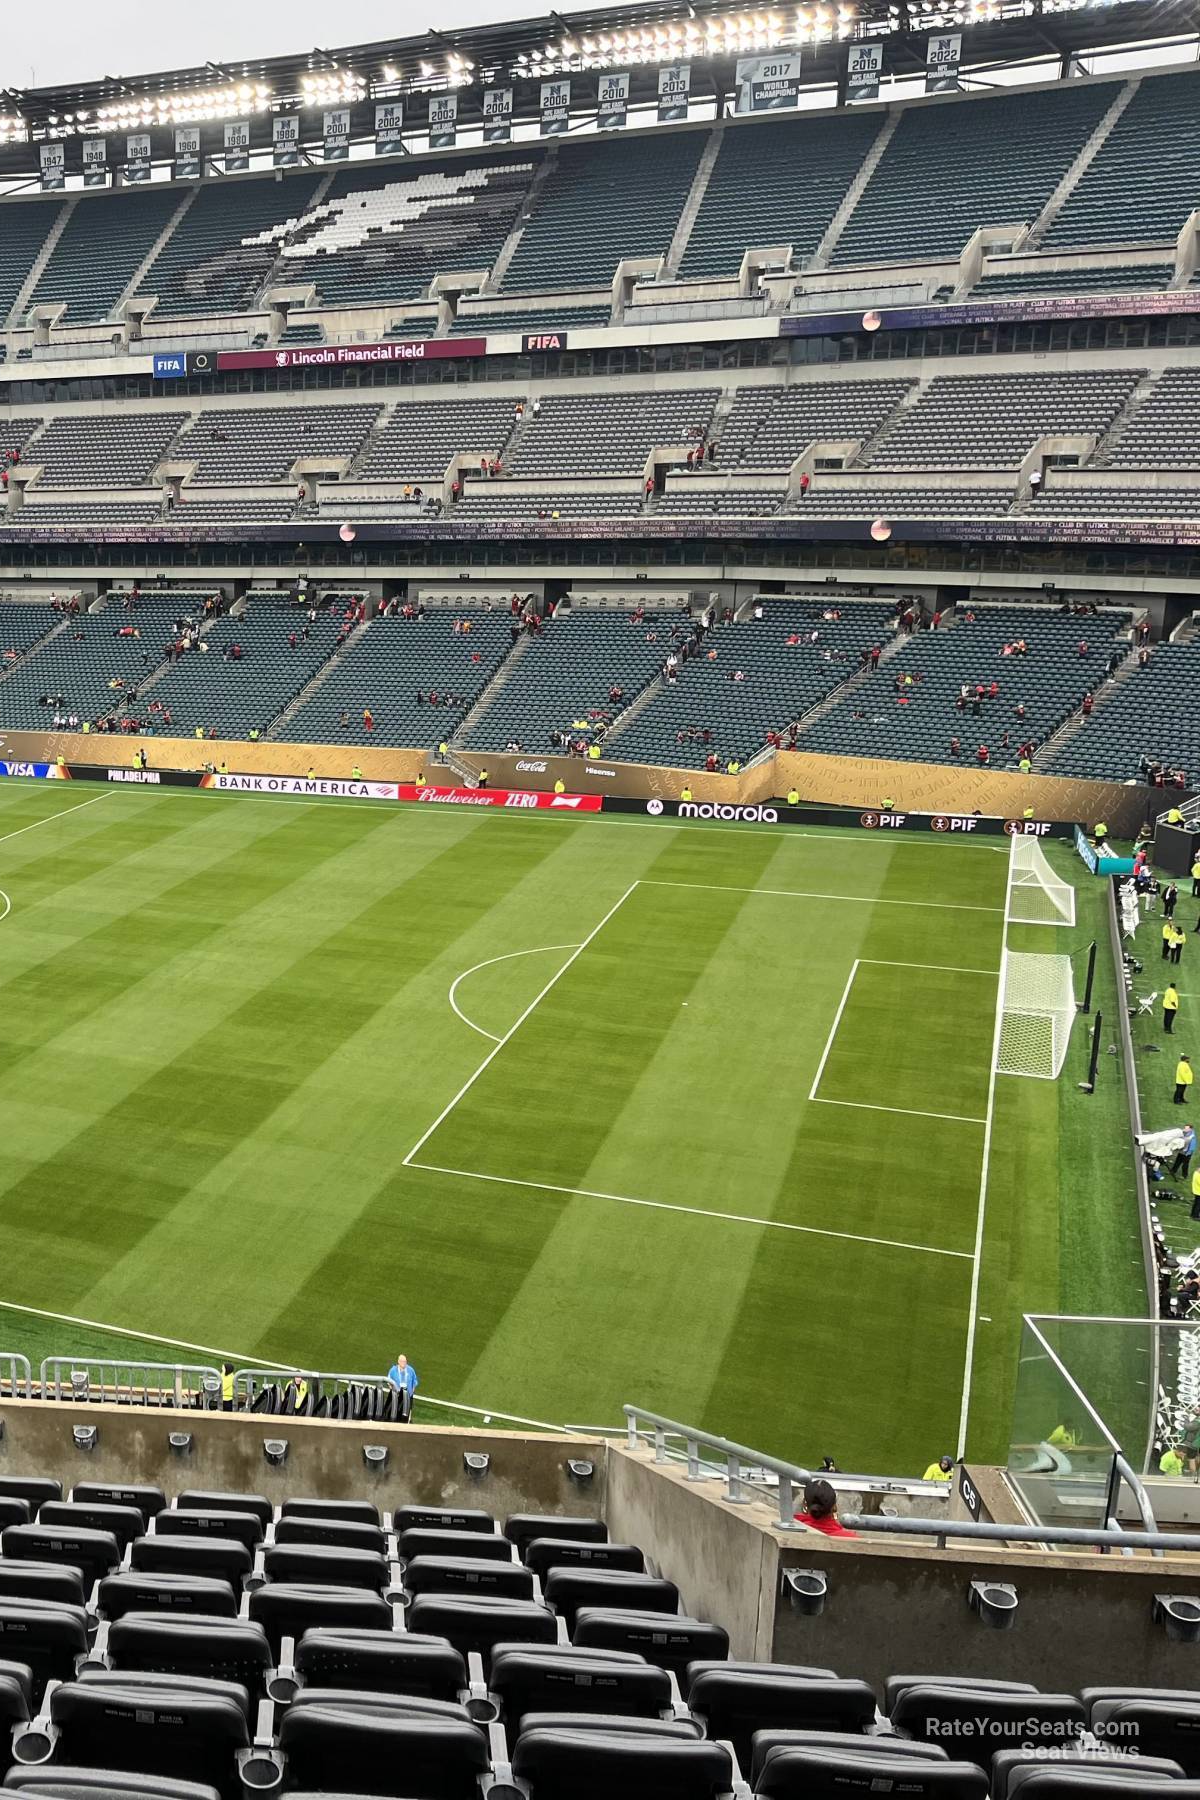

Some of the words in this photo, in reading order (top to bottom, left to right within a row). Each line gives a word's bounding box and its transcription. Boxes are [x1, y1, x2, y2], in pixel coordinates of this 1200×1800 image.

[930, 50, 957, 62] 2022
[763, 64, 791, 76] 2017
[852, 59, 877, 70] 2019
[662, 80, 686, 93] 2013
[763, 81, 789, 90] WORLD
[602, 88, 625, 99] 2010
[755, 88, 796, 100] CHAMPIONS
[543, 95, 567, 107] 2006
[486, 102, 509, 114] 2004
[431, 109, 454, 120] 2003
[378, 117, 400, 128] 2002
[276, 129, 295, 139] 1988
[326, 124, 346, 134] 2001
[179, 140, 197, 151] 1960
[227, 135, 246, 145] 1980
[86, 152, 103, 162] 1948
[130, 147, 148, 157] 1949
[43, 155, 62, 167] 1947
[527, 336, 560, 349] FIFA
[292, 351, 335, 364] Lincoln
[337, 347, 392, 362] Financial
[394, 344, 425, 358] Field
[157, 360, 180, 371] FIFA
[5, 762, 35, 777] VISA
[515, 760, 549, 773] Coca-Cola
[585, 766, 616, 777] Hisense
[107, 769, 161, 784] PHILADELPHIA
[219, 776, 263, 790] BANK
[268, 779, 289, 791] OF
[293, 781, 369, 796] AMERICA
[416, 787, 494, 805] Budweiser
[504, 793, 538, 808] ZERO
[678, 801, 778, 823] motorola
[880, 813, 905, 829] PIF
[951, 817, 977, 832] PIF
[1023, 823, 1051, 835] PIF
[963, 1479, 976, 1510] C5
